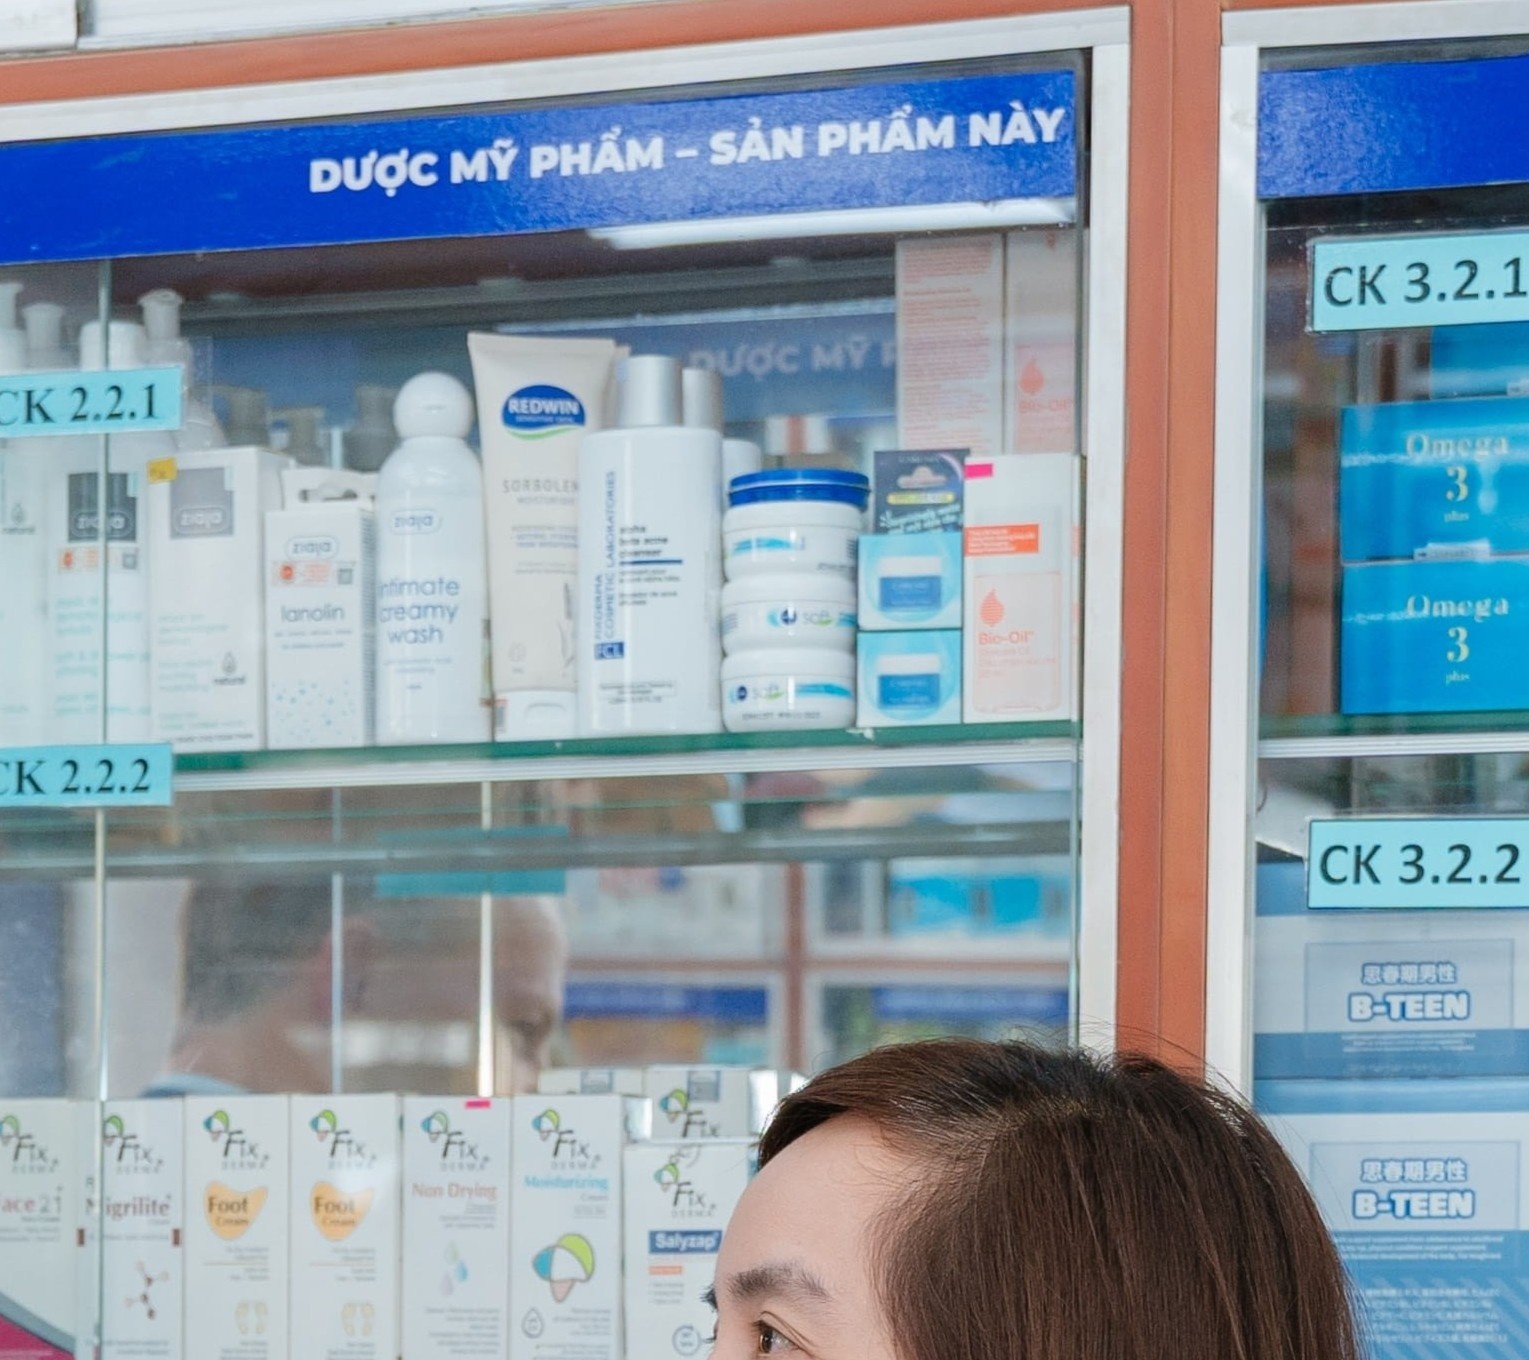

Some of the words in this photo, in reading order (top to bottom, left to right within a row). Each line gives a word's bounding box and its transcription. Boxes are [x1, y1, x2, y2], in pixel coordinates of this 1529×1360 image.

[310, 147, 438, 197] DƯỢC
[450, 138, 518, 184] MỸ
[530, 126, 664, 178] PHẨM
[710, 116, 804, 166] SẢN
[818, 105, 955, 157] PHẨM
[969, 101, 1066, 148] NÀY
[1323, 262, 1388, 308] CK
[1404, 256, 1529, 305] 3.2.1
[70, 382, 160, 423] 2.2.1
[508, 398, 579, 417] REDWIN
[387, 622, 444, 645] wash
[62, 757, 152, 796] 2.2.2
[1320, 842, 1382, 886] CK
[1398, 841, 1522, 887] 3.2.2
[1348, 991, 1471, 1023] B-TEEN
